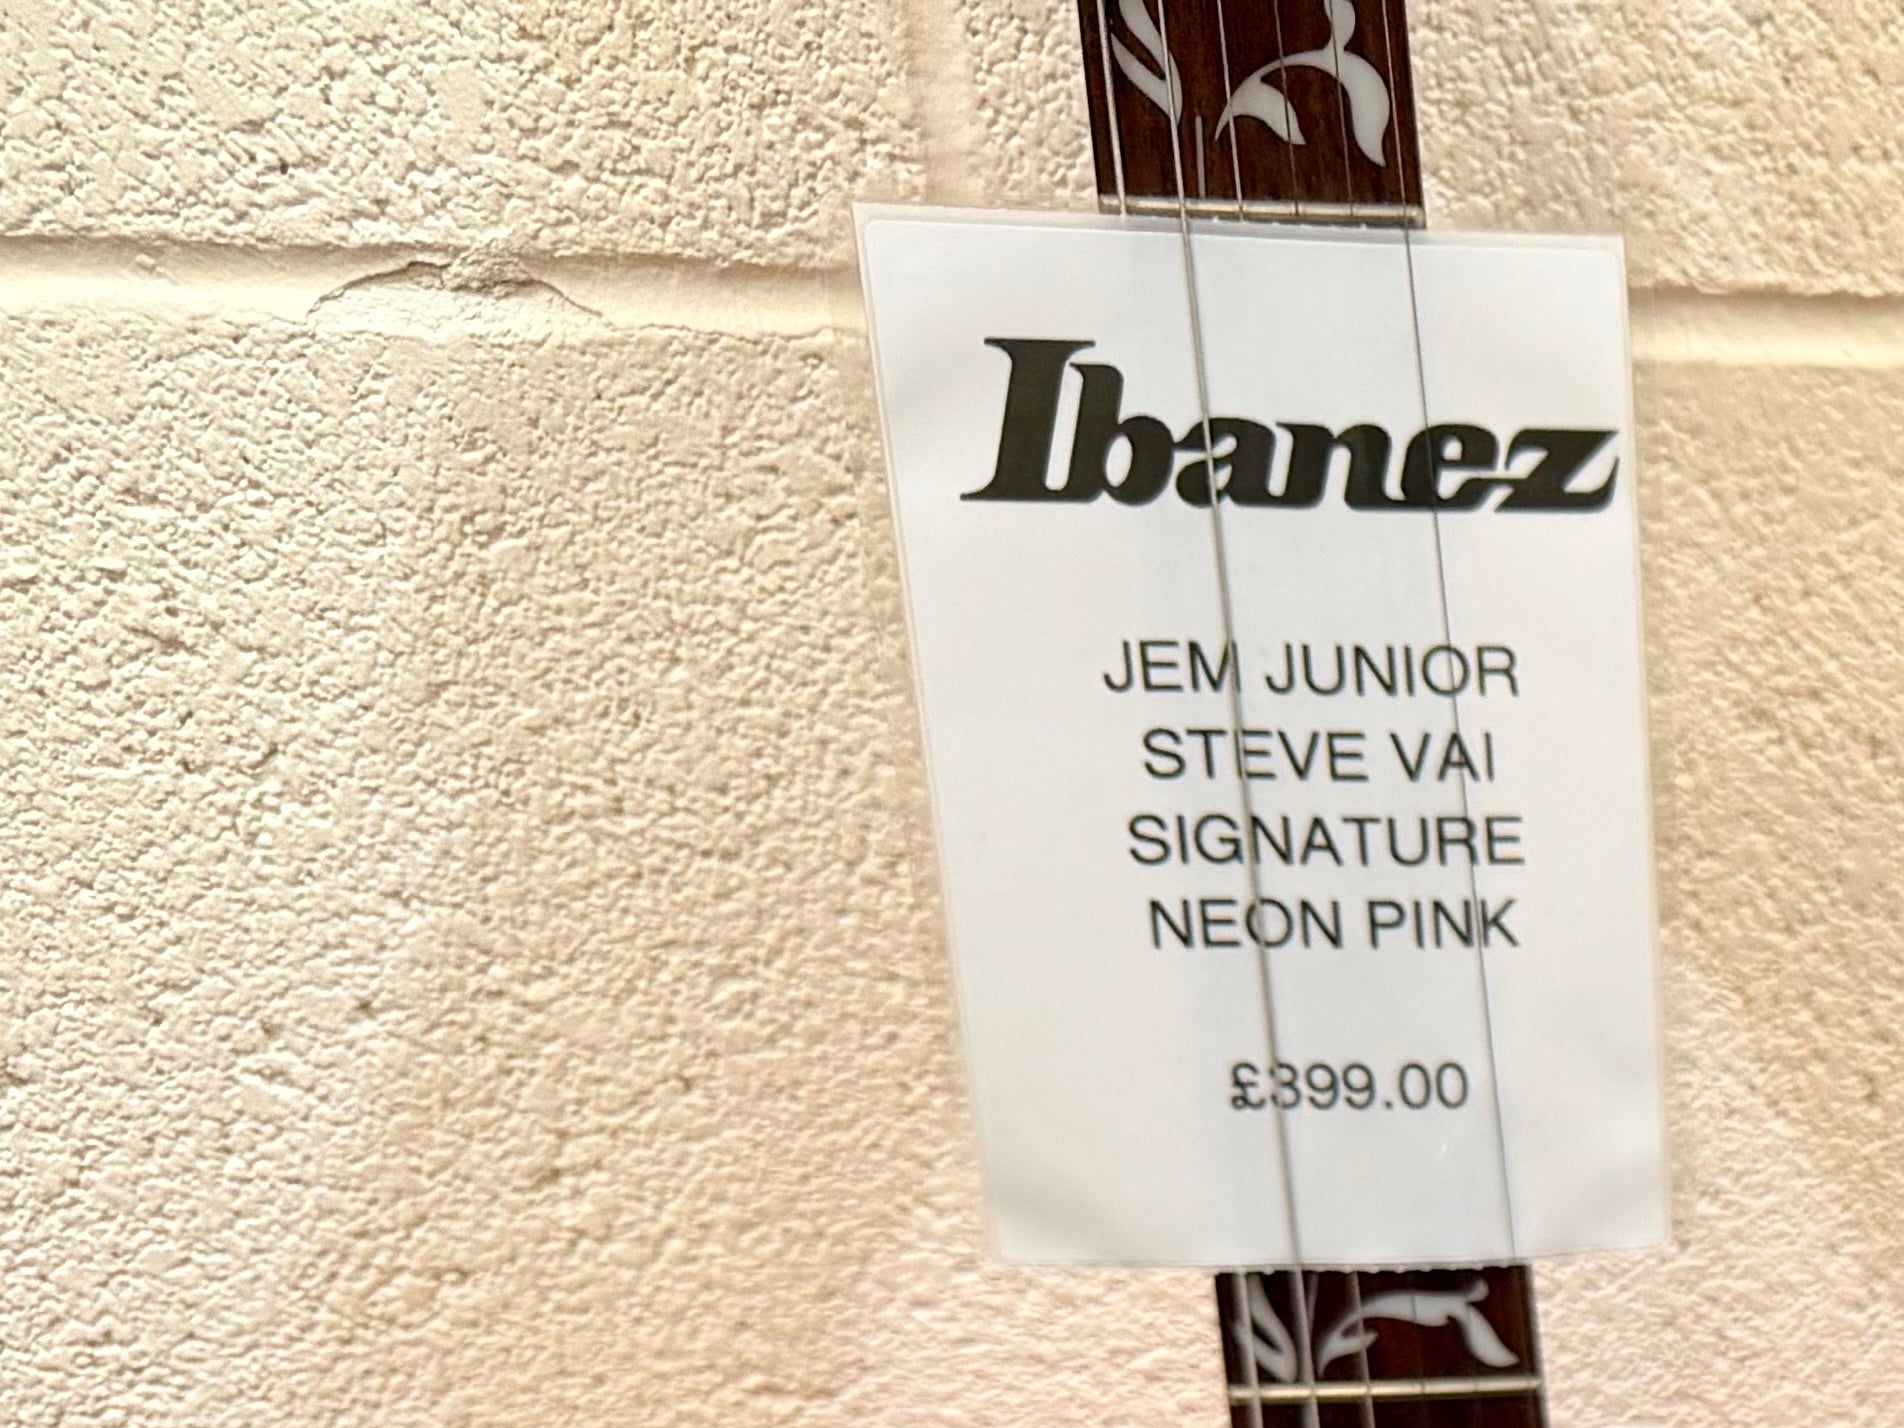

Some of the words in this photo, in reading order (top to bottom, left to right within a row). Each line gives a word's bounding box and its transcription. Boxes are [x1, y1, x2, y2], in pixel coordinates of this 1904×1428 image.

[960, 336, 1620, 513] Ibanez
[1103, 640, 1241, 694] JEM
[1265, 643, 1520, 697] JUNIOR
[1142, 728, 1369, 782] STEVE
[1390, 731, 1496, 783] VAI
[1127, 814, 1525, 867] SIGNATURE
[1148, 898, 1343, 949] NEON
[1368, 898, 1521, 949] PINK
[1230, 1062, 1468, 1110] £399.00
